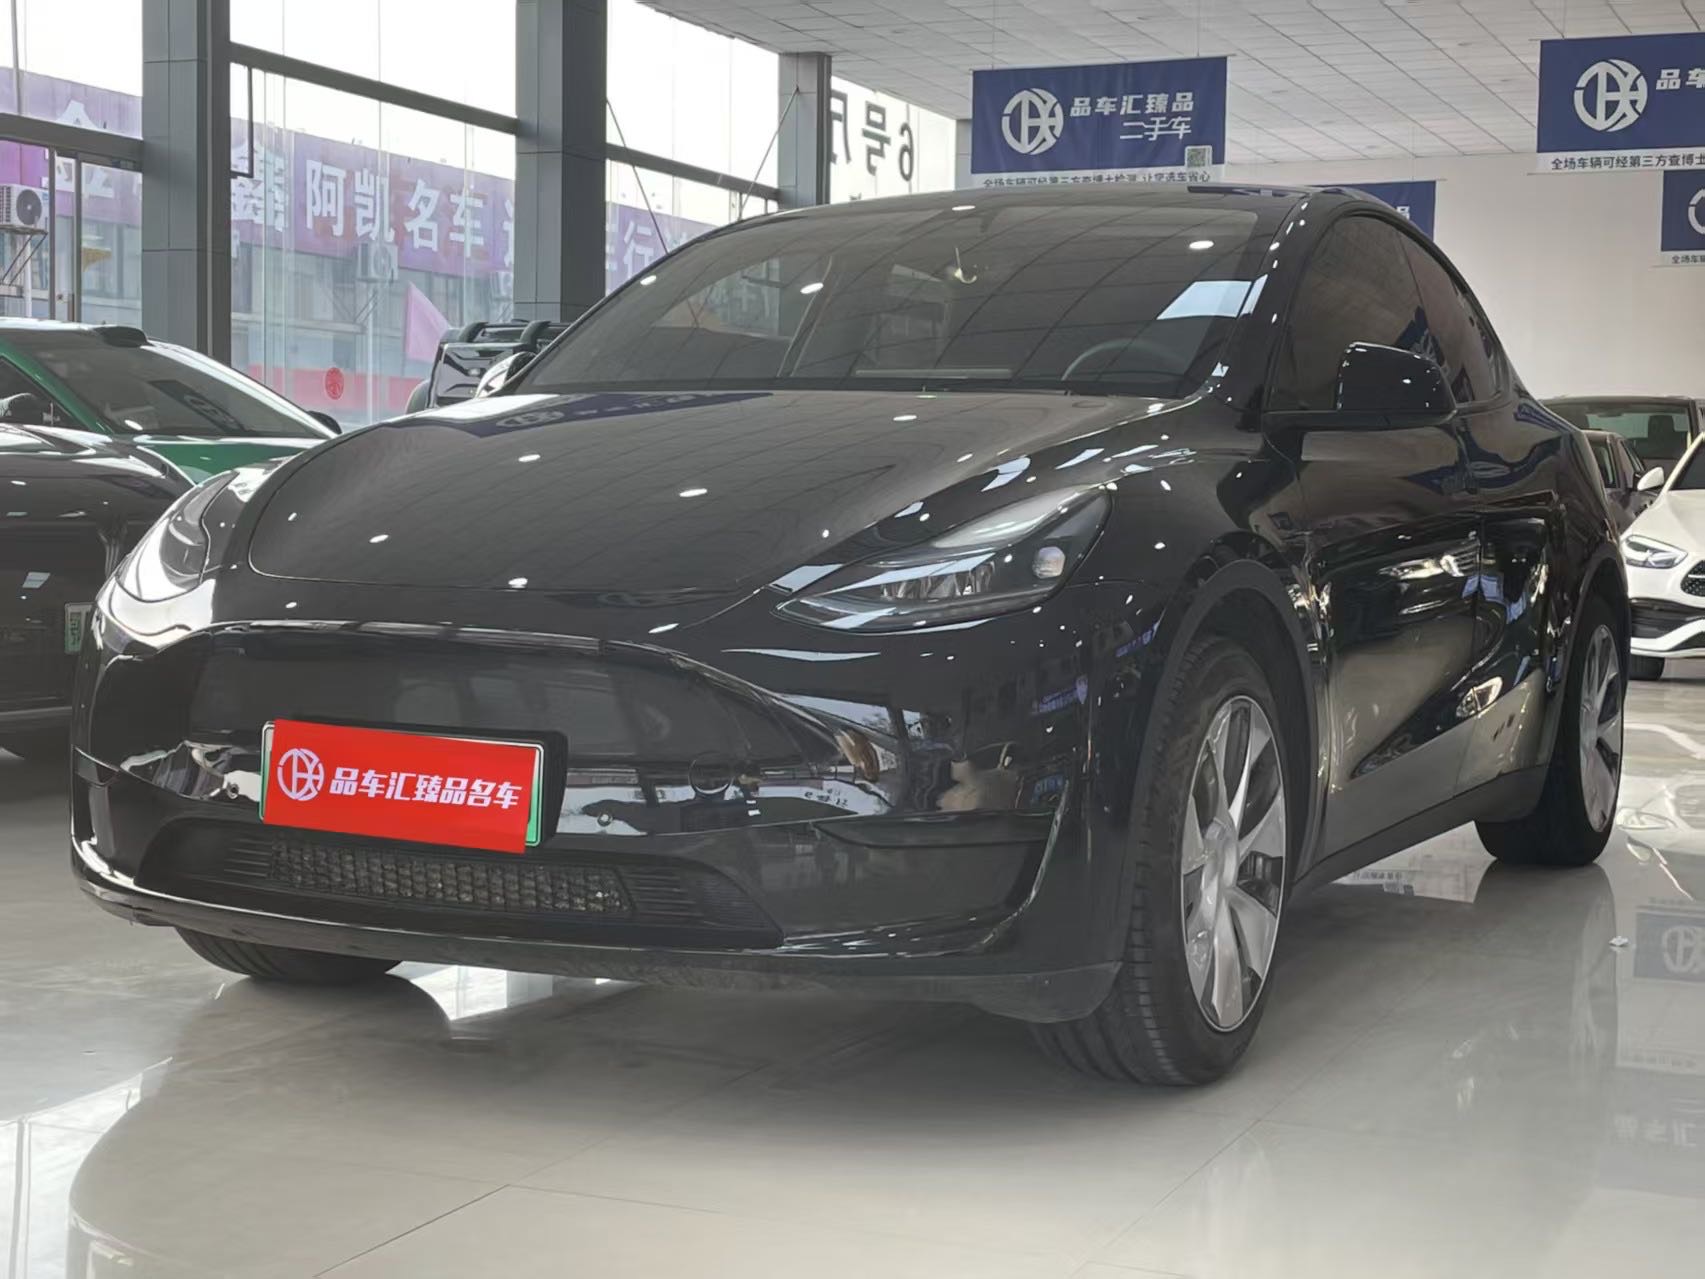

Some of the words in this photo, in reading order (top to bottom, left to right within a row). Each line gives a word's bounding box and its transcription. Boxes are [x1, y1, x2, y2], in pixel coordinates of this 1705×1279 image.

[1070, 91, 1194, 117] 品车汇臻品
[1119, 116, 1192, 141] 二手车
[306, 159, 515, 267] 阿凯名车
[329, 766, 522, 810] 品车汇臻品名车
